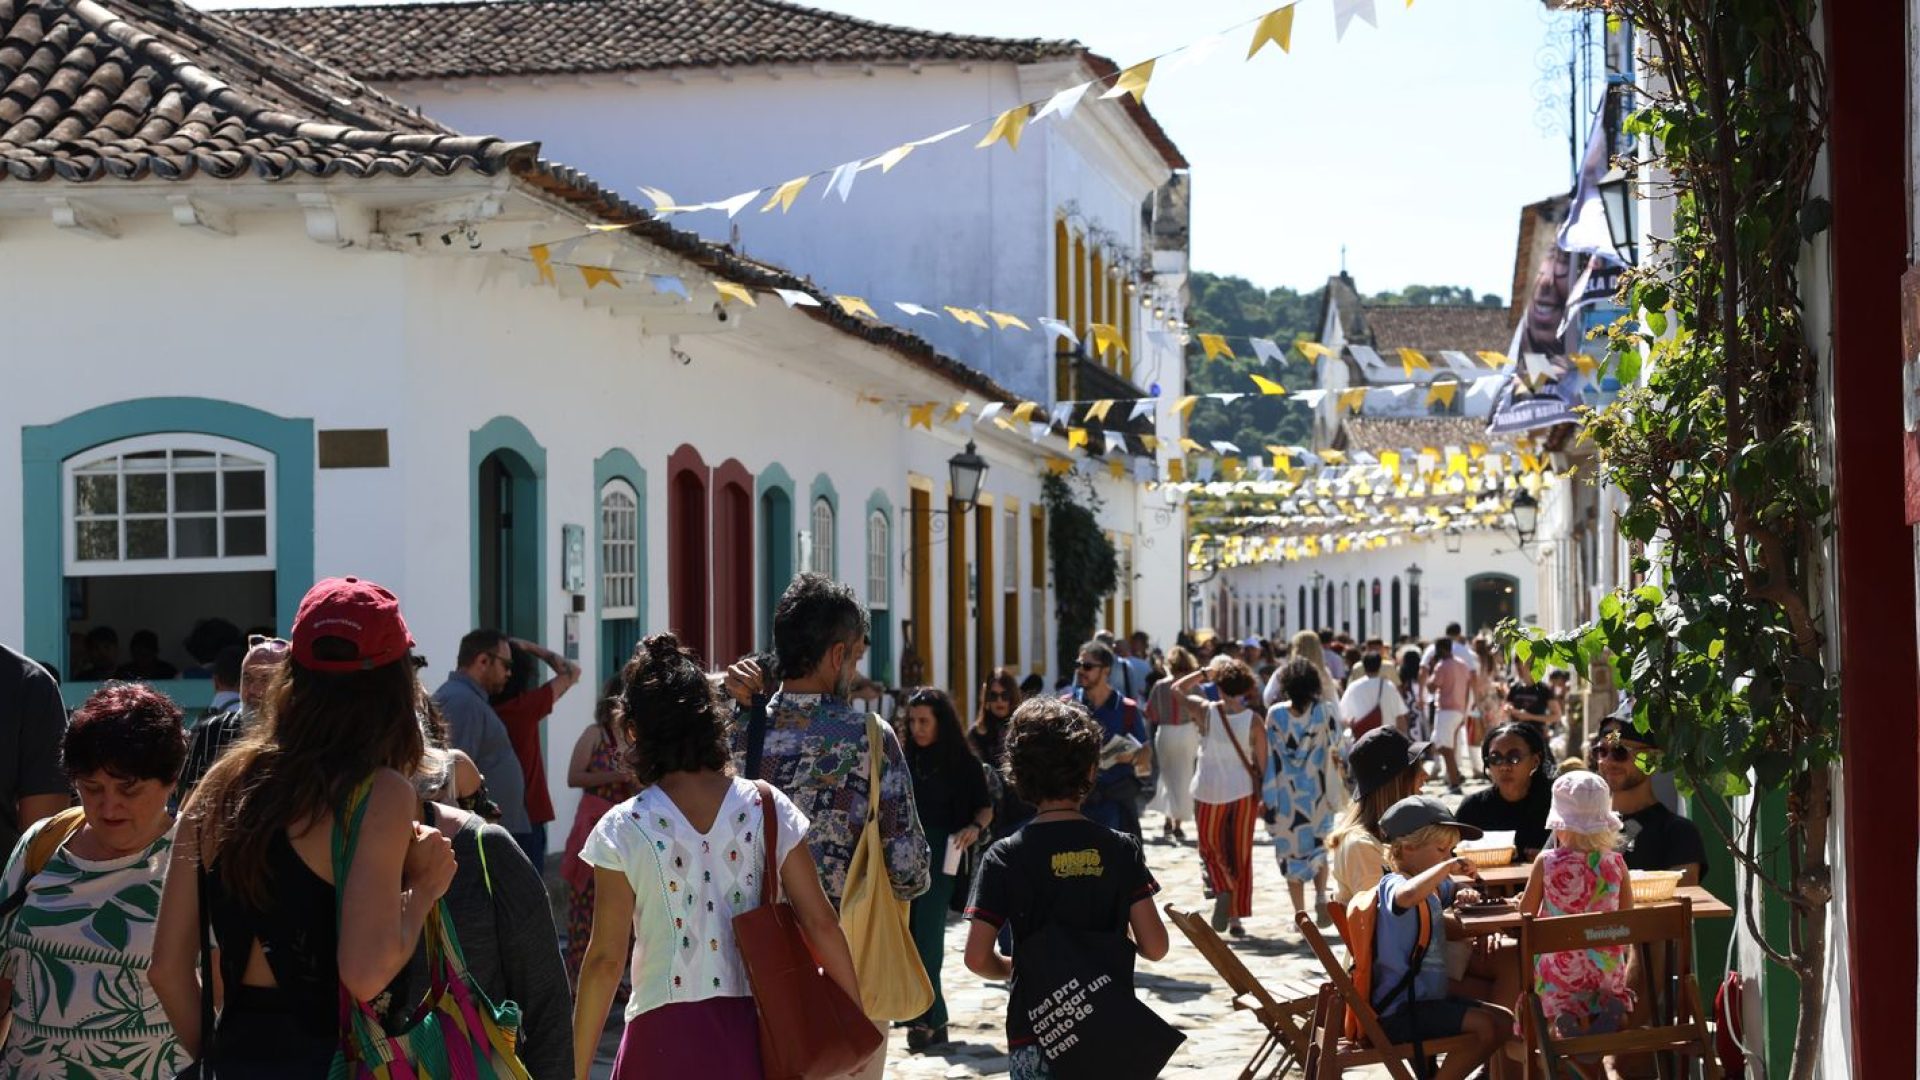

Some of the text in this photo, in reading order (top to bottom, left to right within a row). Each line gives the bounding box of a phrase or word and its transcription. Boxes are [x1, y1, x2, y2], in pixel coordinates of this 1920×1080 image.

[1033, 974, 1112, 1034] carregar um
[1052, 977, 1080, 1004] pra
[1039, 1003, 1094, 1047] tanto de
[1045, 1033, 1079, 1059] trem
